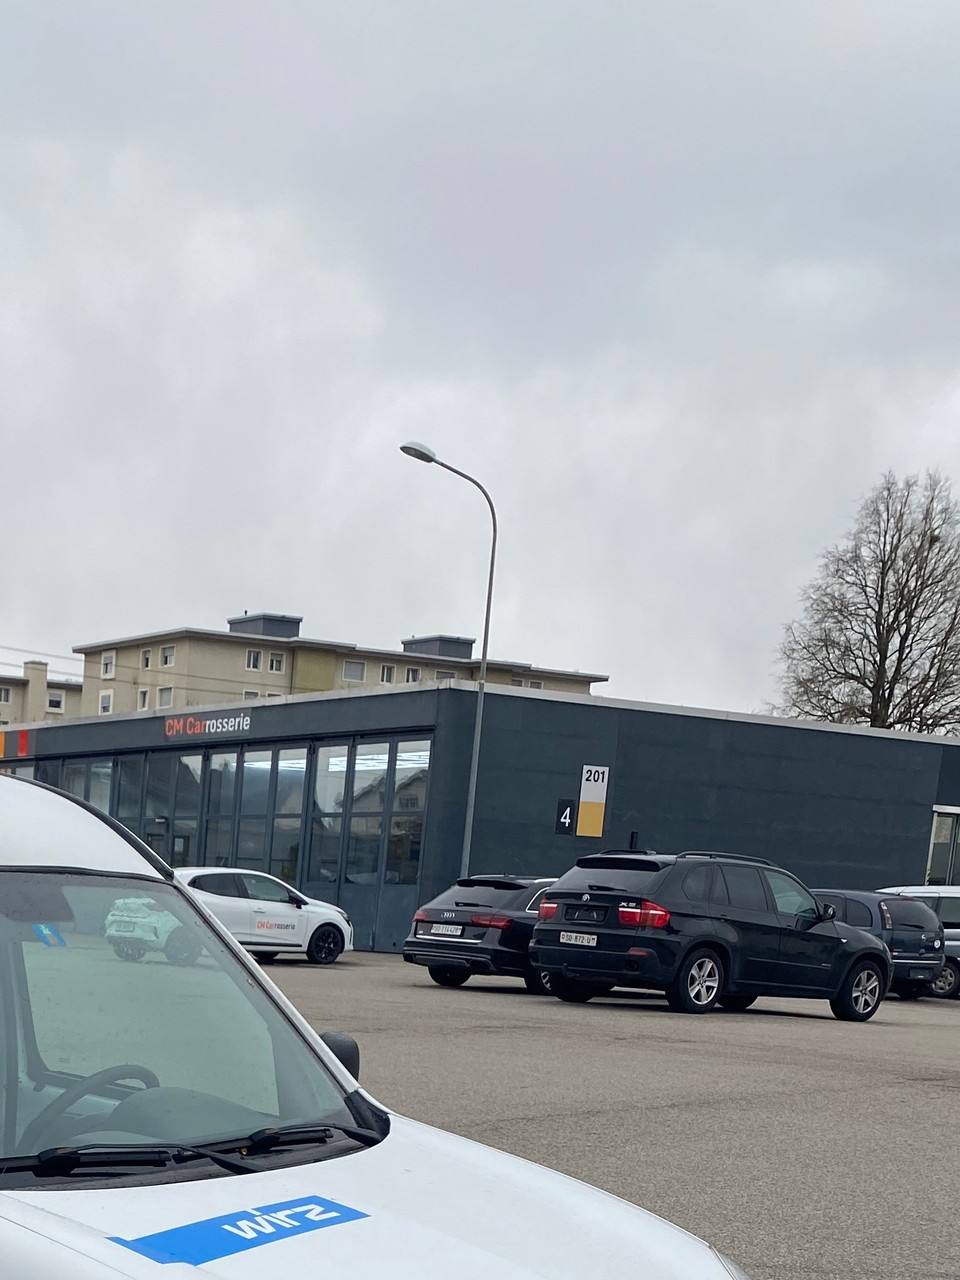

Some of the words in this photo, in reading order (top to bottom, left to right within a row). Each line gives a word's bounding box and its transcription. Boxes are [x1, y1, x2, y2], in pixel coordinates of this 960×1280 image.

[165, 718, 184, 736] CM
[186, 713, 251, 734] Carrosserie
[585, 769, 606, 783] 201
[560, 806, 571, 827] 4
[265, 921, 296, 930] Carrosserie
[220, 1203, 342, 1240] wirz
